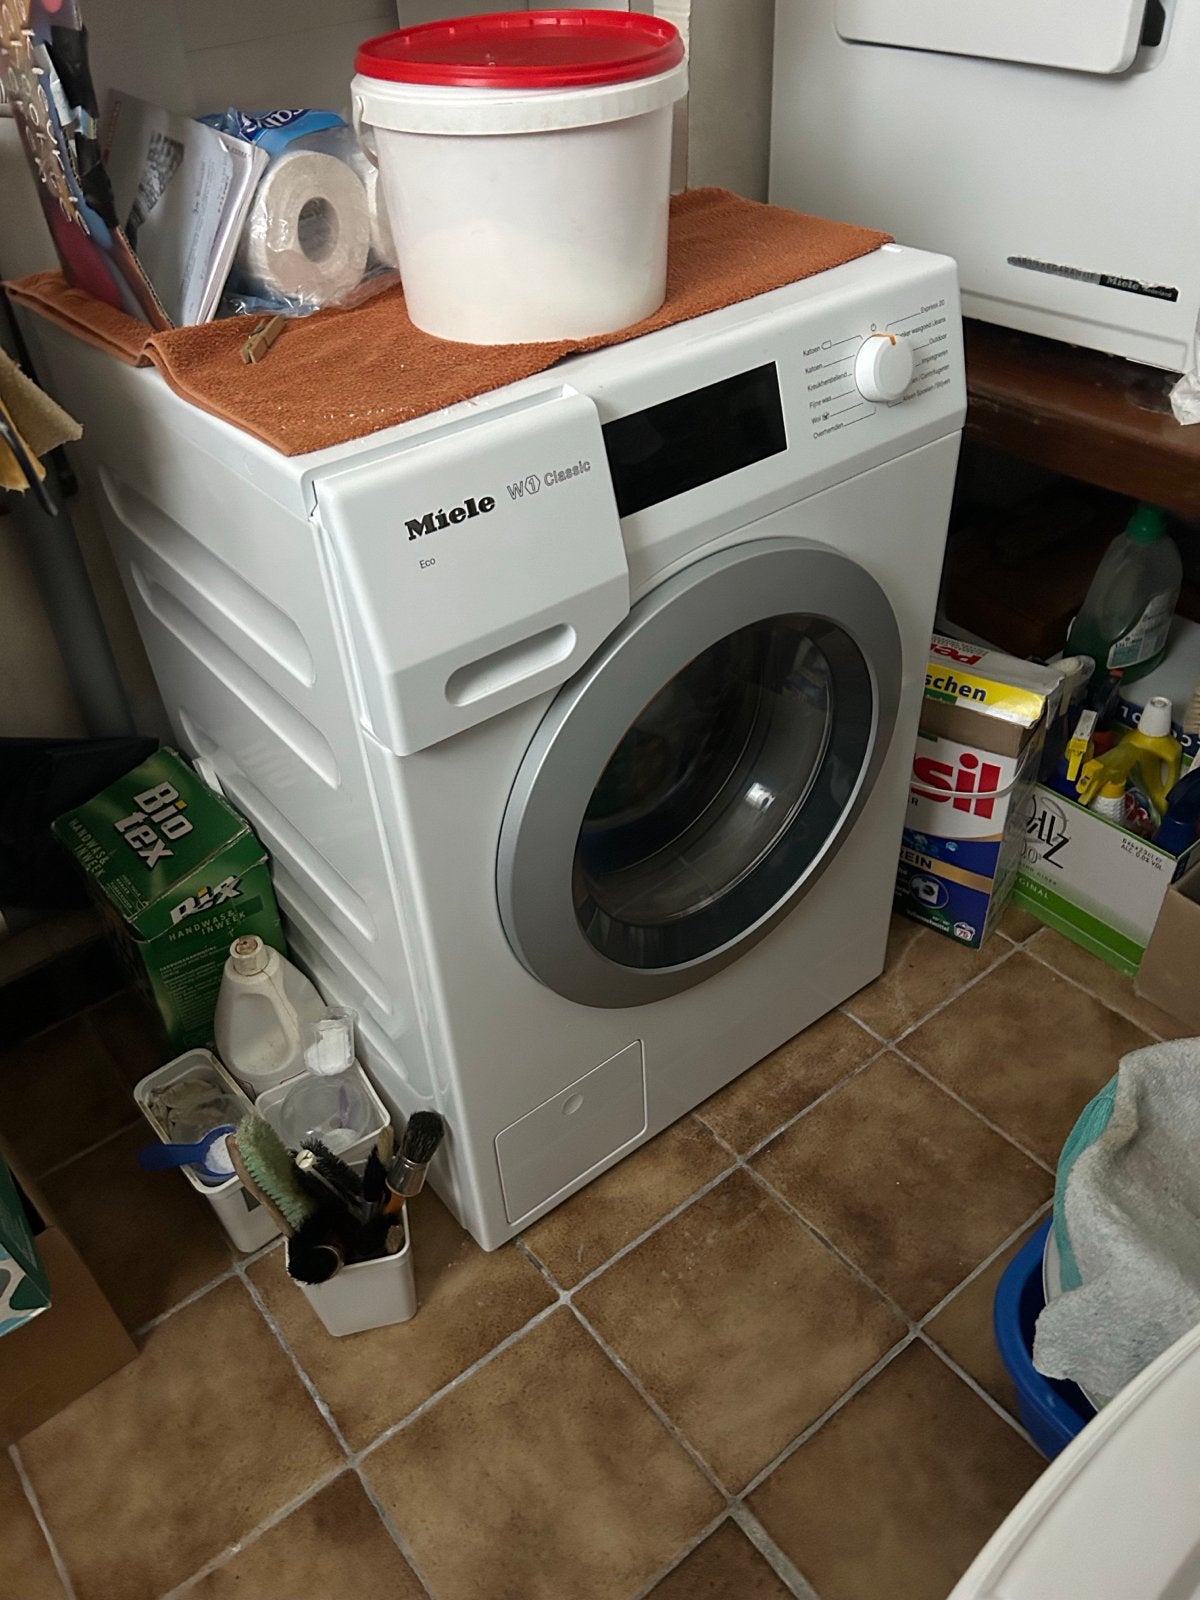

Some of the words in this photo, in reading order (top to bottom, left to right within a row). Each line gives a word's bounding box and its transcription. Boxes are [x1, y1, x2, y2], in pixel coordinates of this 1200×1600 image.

[1106, 275, 1140, 291] Miele
[920, 302, 937, 314] Express
[928, 333, 948, 345] Outdoor
[803, 346, 821, 357] Katoen
[805, 363, 823, 374] Katoen
[813, 423, 844, 439] Overhemden
[404, 495, 496, 541] Miele
[543, 460, 591, 487] Classic
[419, 557, 436, 570] Eco
[133, 780, 194, 840] Bio
[114, 811, 175, 868] tex
